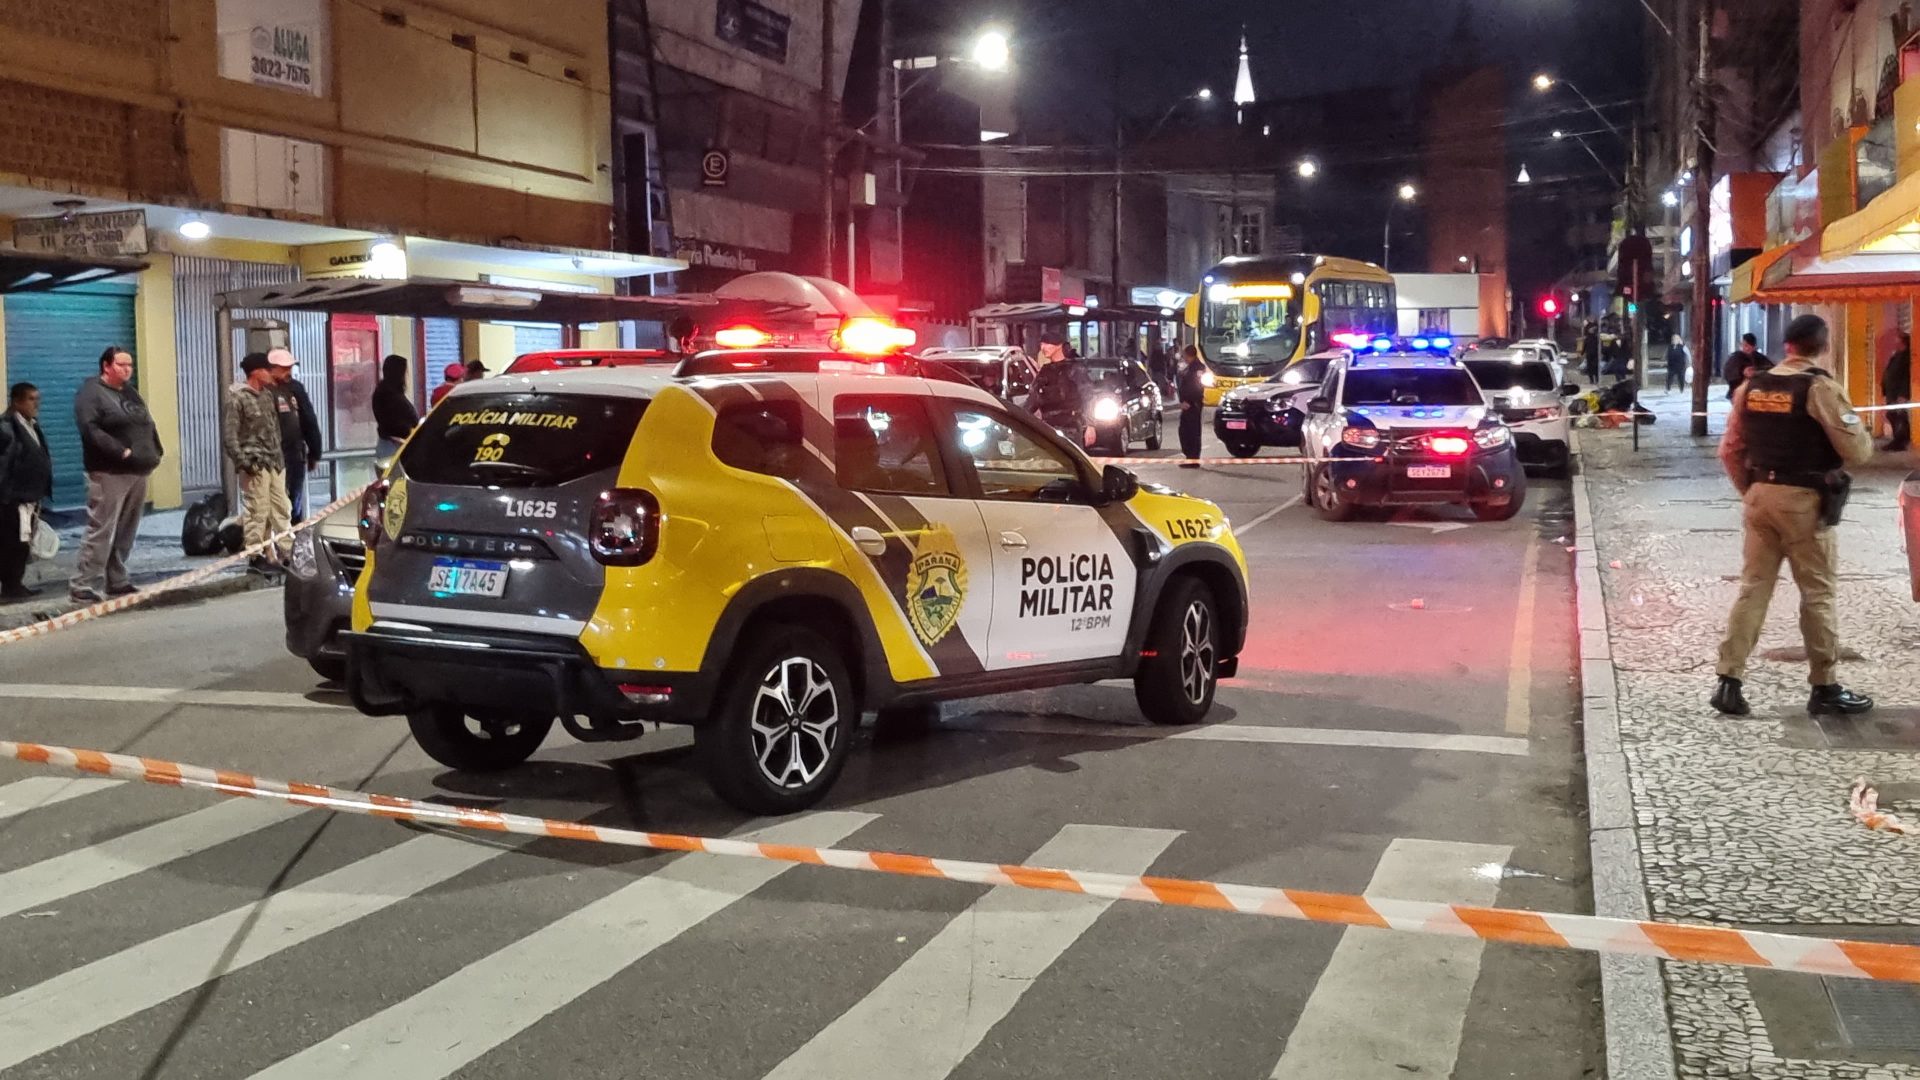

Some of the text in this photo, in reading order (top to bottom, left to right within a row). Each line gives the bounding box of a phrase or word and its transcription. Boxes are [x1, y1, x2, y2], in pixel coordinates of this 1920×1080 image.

[273, 26, 310, 64] ALUGA
[449, 409, 577, 429] POLÍCIA MILITAR
[474, 446, 505, 462] 190
[506, 500, 558, 519] L1625
[1165, 518, 1217, 540] L1625
[1021, 553, 1114, 586] POLÍCIA
[1019, 583, 1114, 618] MILITAR
